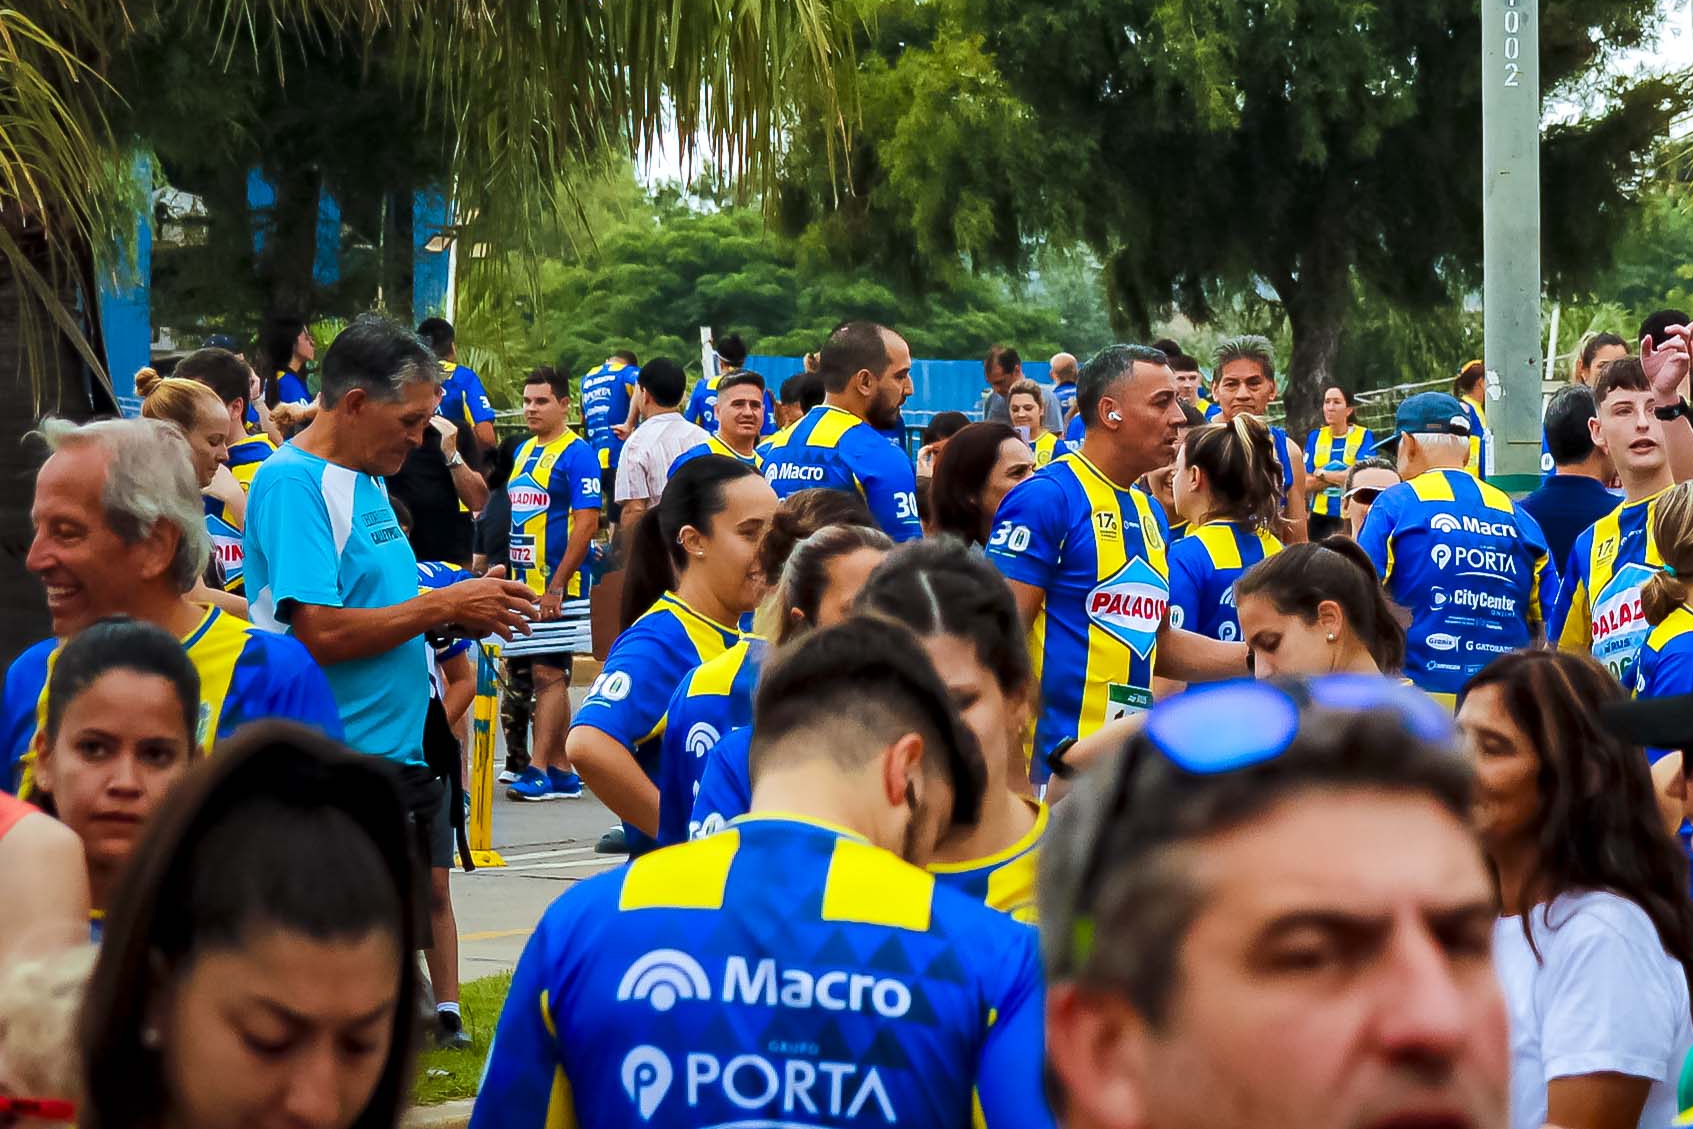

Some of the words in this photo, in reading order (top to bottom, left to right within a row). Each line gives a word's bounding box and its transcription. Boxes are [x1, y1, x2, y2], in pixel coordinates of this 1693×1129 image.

[581, 477, 600, 494] 30
[779, 462, 824, 481] Macro
[510, 493, 548, 506] LADINI
[893, 491, 919, 519] 30
[989, 520, 1031, 552] 30
[1455, 546, 1517, 575] PORTA
[1091, 592, 1168, 621] PALADIN
[1454, 588, 1516, 611] CityCenter
[722, 955, 912, 1018] Macro
[768, 1039, 820, 1055] GRUPO
[686, 1052, 897, 1124] PORTA
